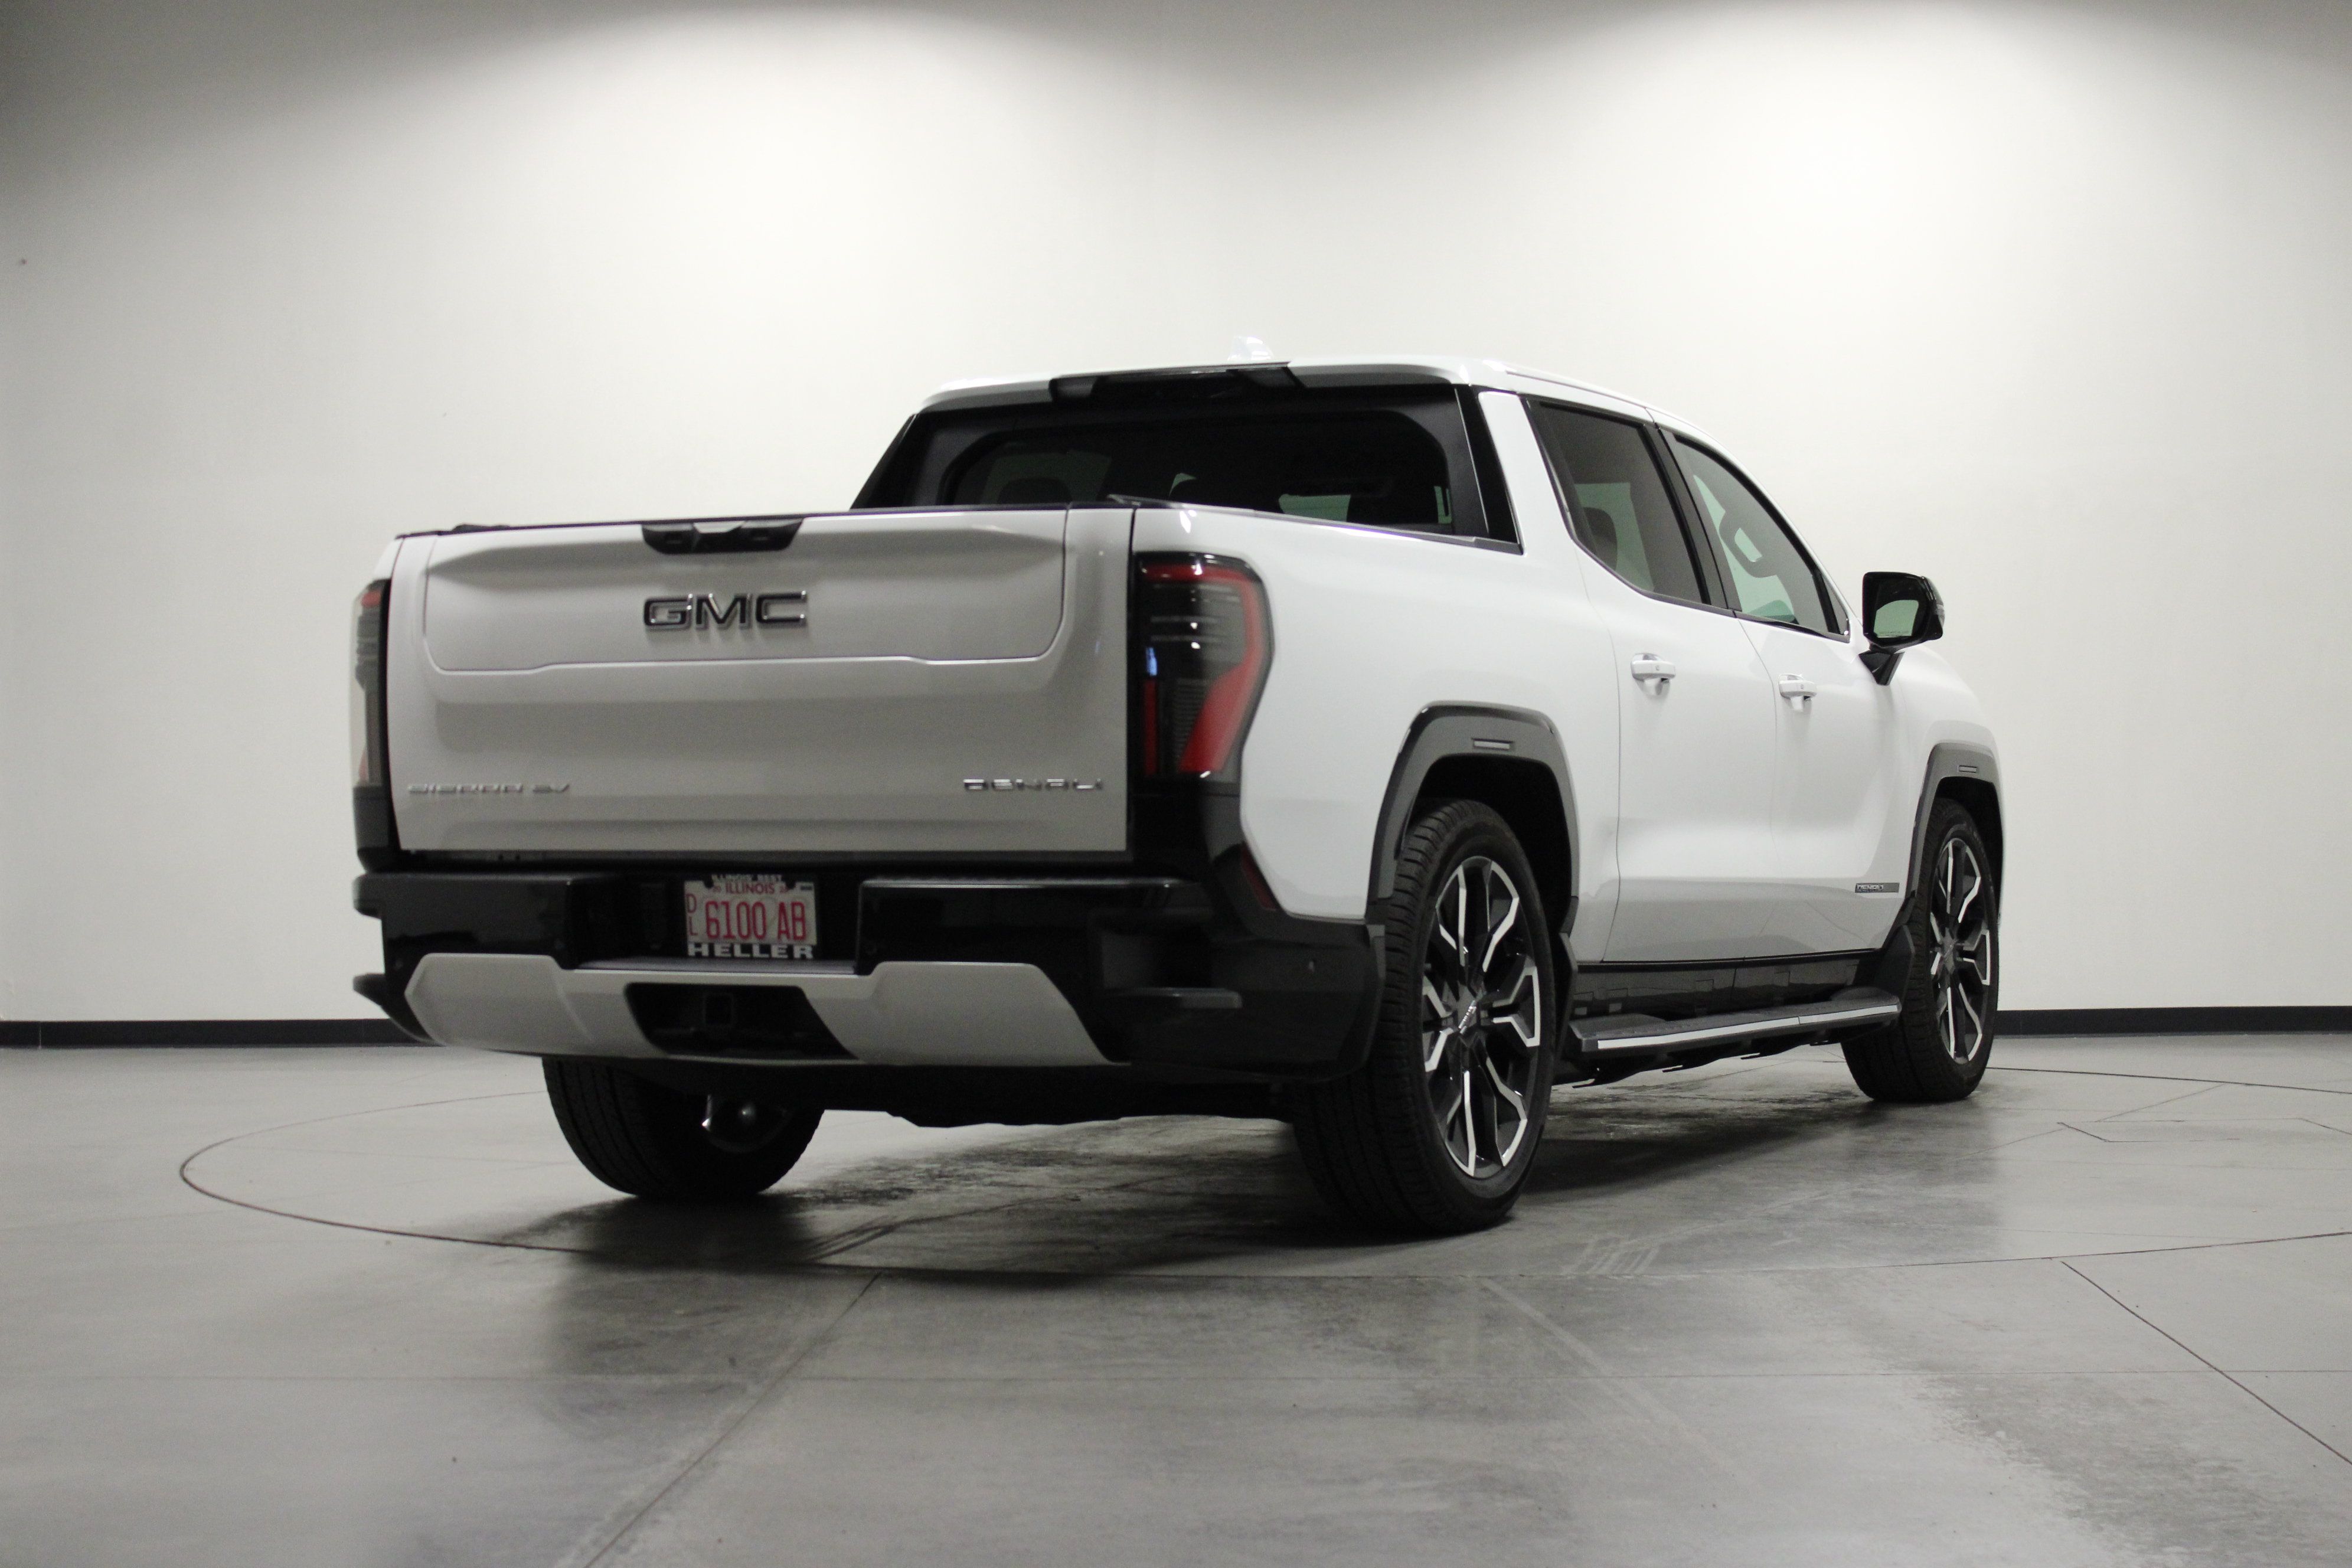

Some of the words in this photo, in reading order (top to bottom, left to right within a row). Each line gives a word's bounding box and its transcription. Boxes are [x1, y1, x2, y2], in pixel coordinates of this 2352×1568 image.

[643, 590, 808, 630] GMC
[725, 882, 775, 894] ILLINOIS
[705, 900, 766, 940] 6100
[777, 901, 807, 941] AB
[687, 943, 814, 959] HELLER
